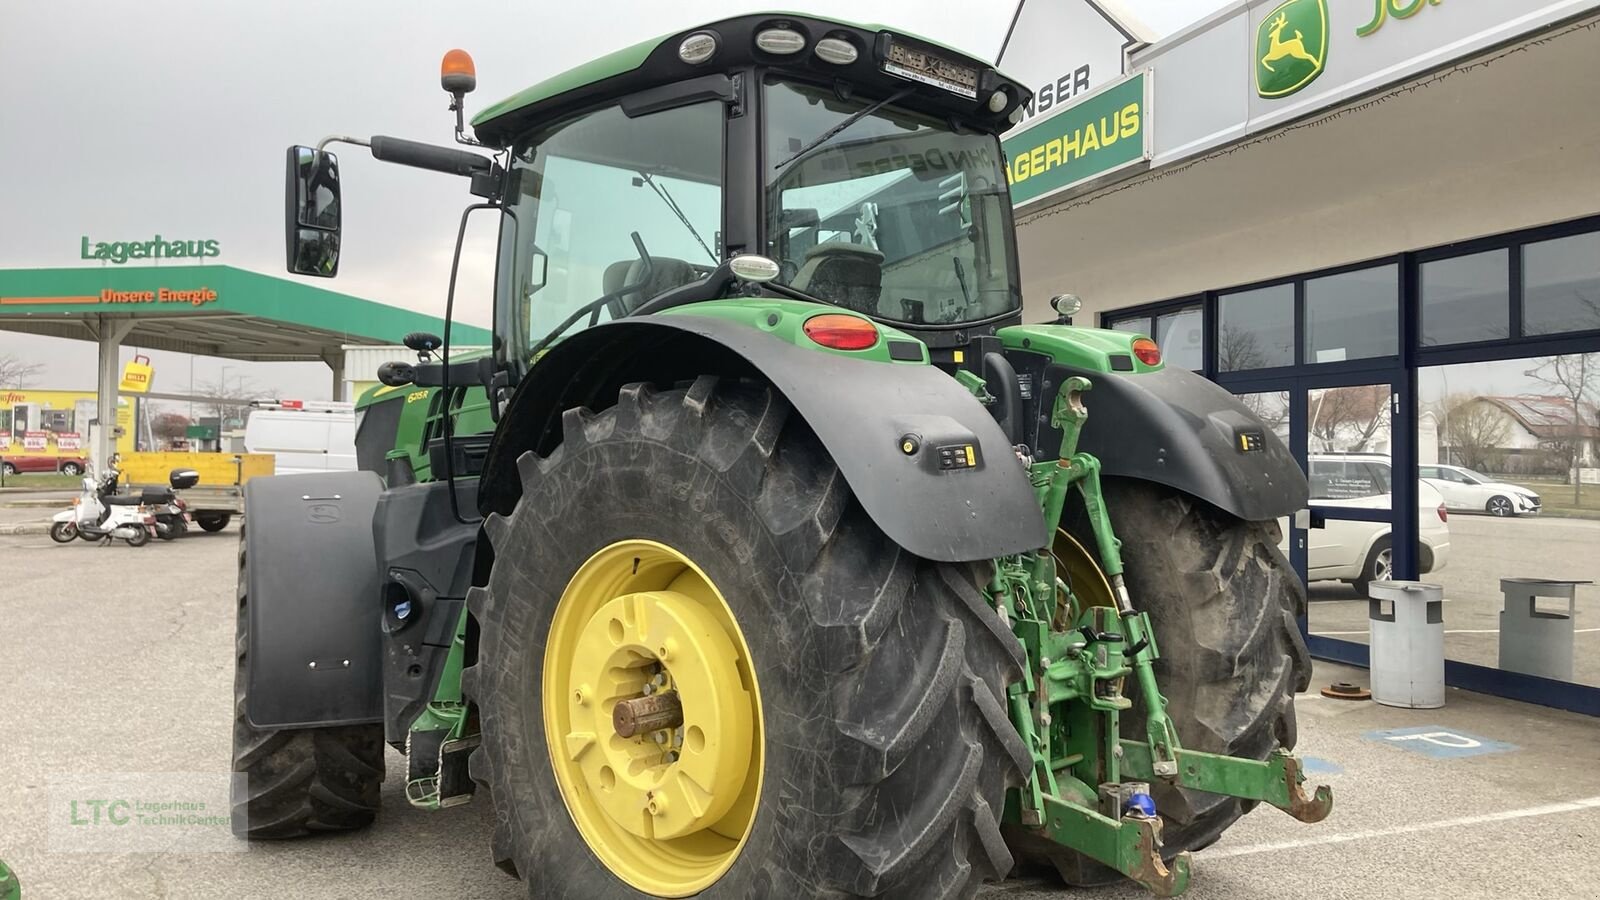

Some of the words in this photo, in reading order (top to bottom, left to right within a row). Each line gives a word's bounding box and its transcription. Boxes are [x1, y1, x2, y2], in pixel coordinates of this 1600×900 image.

[81, 234, 220, 264] Lagerhaus
[101, 288, 154, 303] Unsere
[158, 286, 216, 306] Energie
